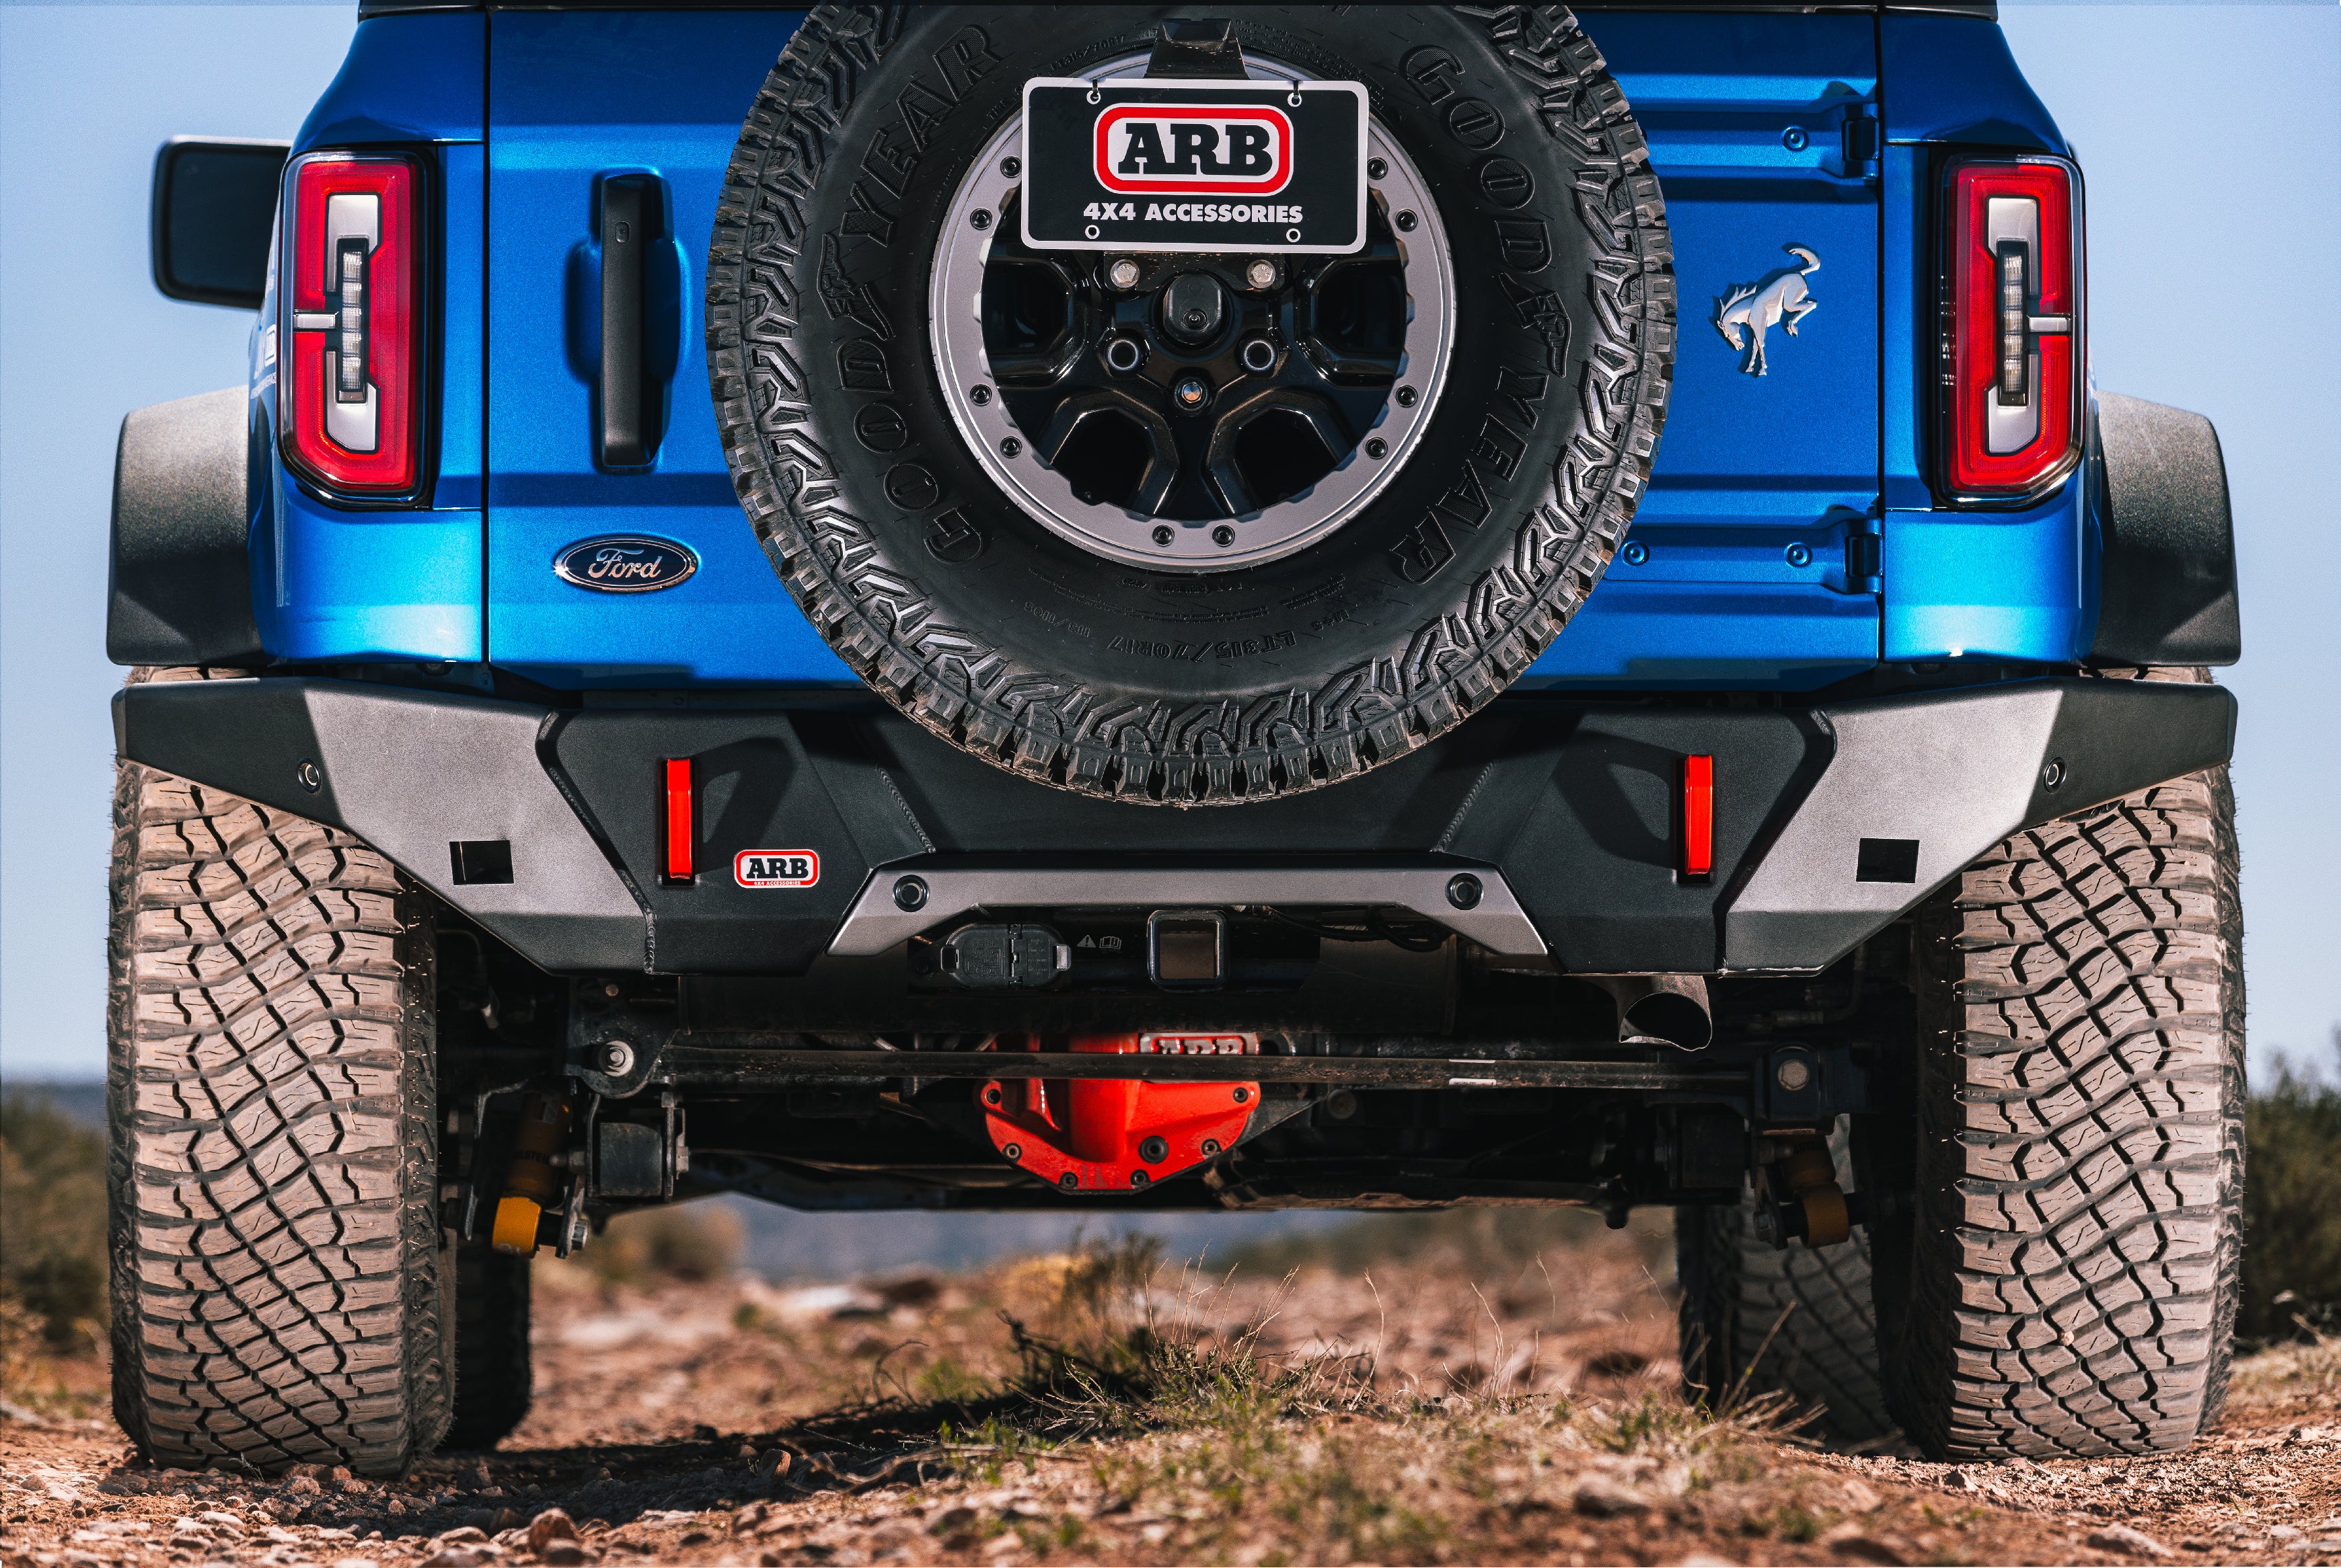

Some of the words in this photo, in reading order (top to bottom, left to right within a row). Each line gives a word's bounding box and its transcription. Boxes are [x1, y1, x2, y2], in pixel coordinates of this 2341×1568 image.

[1117, 122, 1273, 176] ARB
[1083, 202, 1136, 221] 4X4
[1144, 203, 1303, 223] ACCESSORIES
[588, 548, 663, 578] Ford
[1105, 630, 1297, 663] LT315/70R17
[747, 858, 809, 879] ARB
